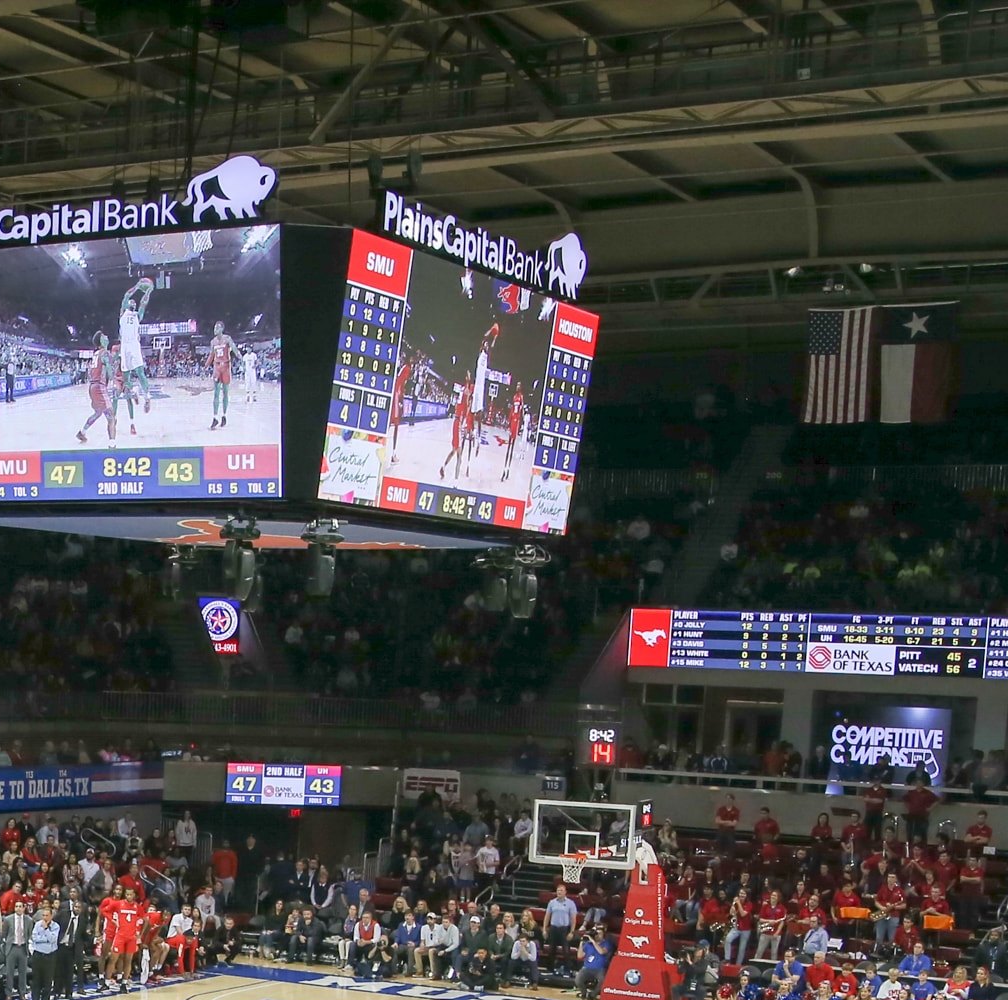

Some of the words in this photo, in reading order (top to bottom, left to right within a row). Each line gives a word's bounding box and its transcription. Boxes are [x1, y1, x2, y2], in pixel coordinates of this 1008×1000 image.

[366, 250, 394, 277] SMU
[559, 319, 592, 342] HOUSTON
[341, 405, 348, 422] 4
[370, 412, 378, 428] 3
[329, 447, 369, 466] Central
[542, 450, 548, 464] 5
[563, 455, 569, 469] 2
[51, 466, 76, 484] 47
[103, 457, 151, 477] 8:42
[165, 463, 193, 481] 43
[227, 454, 255, 470] UH
[332, 464, 376, 485] Market
[14, 487, 27, 496] TOL
[30, 486, 38, 496] 3
[98, 483, 117, 494] 2ND
[121, 482, 143, 494] HALF
[208, 484, 222, 494] FLS
[230, 483, 238, 494] 5
[248, 483, 263, 493] TOL
[267, 482, 275, 493] 2
[532, 485, 561, 500] Central
[387, 486, 409, 503] SMU
[419, 491, 434, 510] 47
[443, 495, 465, 514] 8:42
[478, 502, 492, 520] 43
[504, 506, 516, 520] UH
[468, 508, 472, 519] 2
[674, 611, 698, 620] PLAYER
[741, 613, 754, 621] PTS
[760, 613, 774, 622] REB
[779, 614, 793, 622] AST
[798, 614, 807, 622] PF
[834, 650, 869, 660] BANK
[900, 651, 921, 660] PITT
[947, 653, 961, 661] 45
[834, 661, 849, 670] OF
[852, 662, 892, 671] TEXAS
[899, 664, 938, 673] VATECH
[968, 659, 976, 668] 2
[589, 729, 614, 742] 8:42
[832, 724, 943, 750] COMPETITIVE
[593, 744, 611, 763] 14
[266, 767, 282, 776] 2ND
[284, 768, 302, 776] HALF
[9, 780, 24, 799] TO
[232, 777, 256, 791] 47
[310, 779, 334, 793] 43
[546, 782, 559, 790] 115
